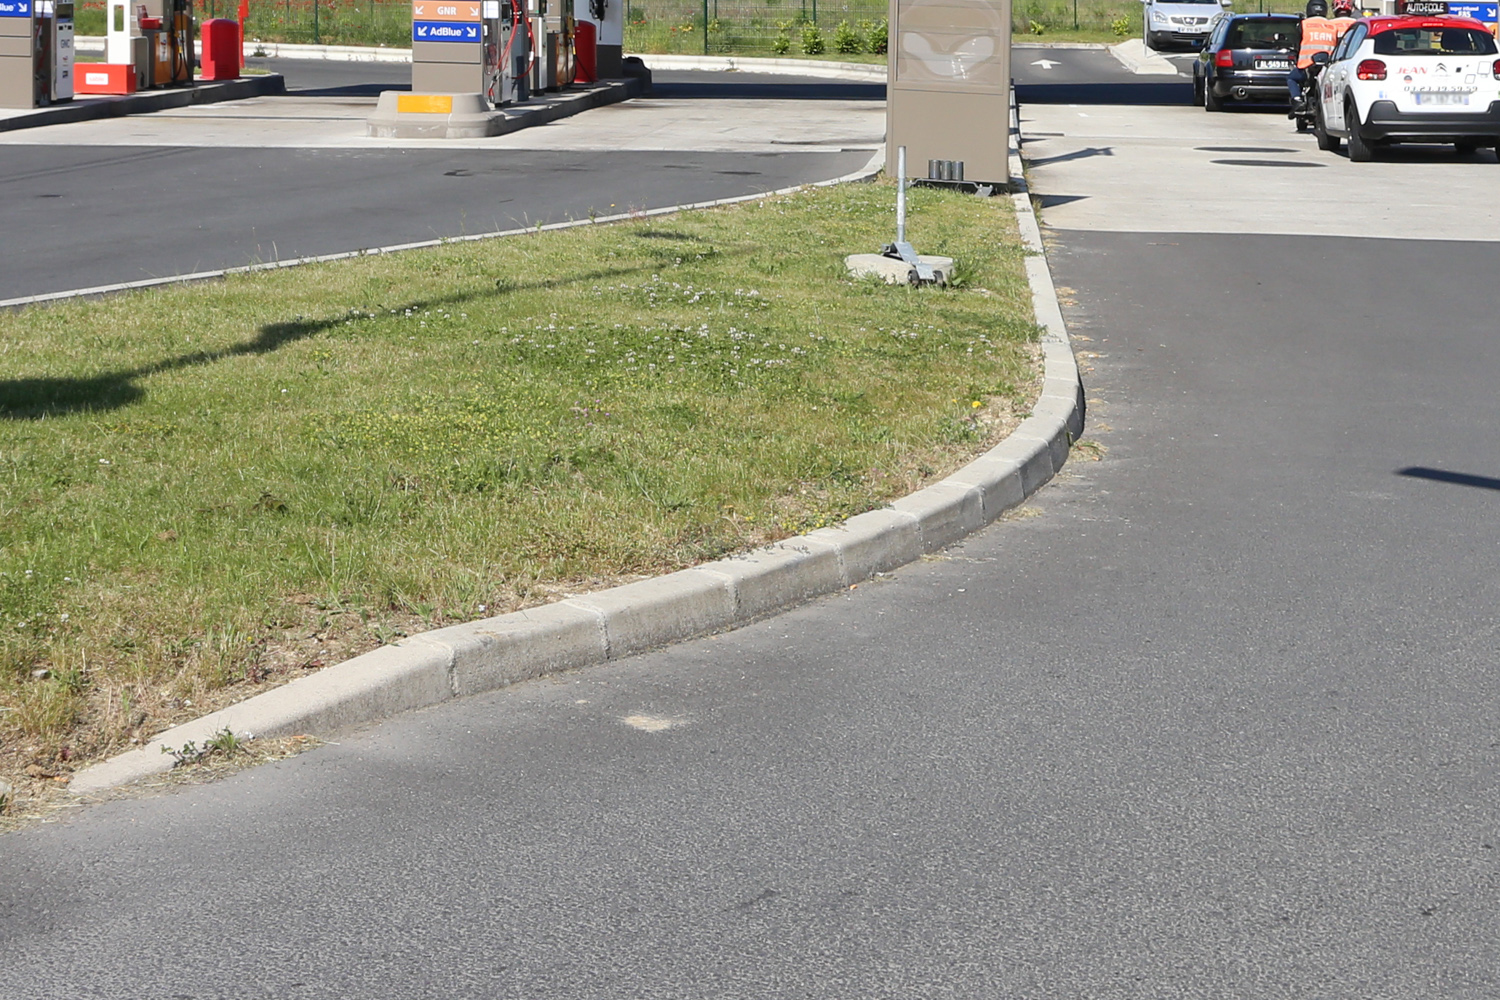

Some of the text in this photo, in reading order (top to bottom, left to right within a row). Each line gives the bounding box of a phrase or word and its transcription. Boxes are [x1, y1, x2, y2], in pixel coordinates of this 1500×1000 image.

[436, 6, 457, 15] GNR
[429, 26, 462, 37] AdBlue
[1309, 31, 1333, 42] JEAN
[1395, 66, 1428, 75] JEAN
